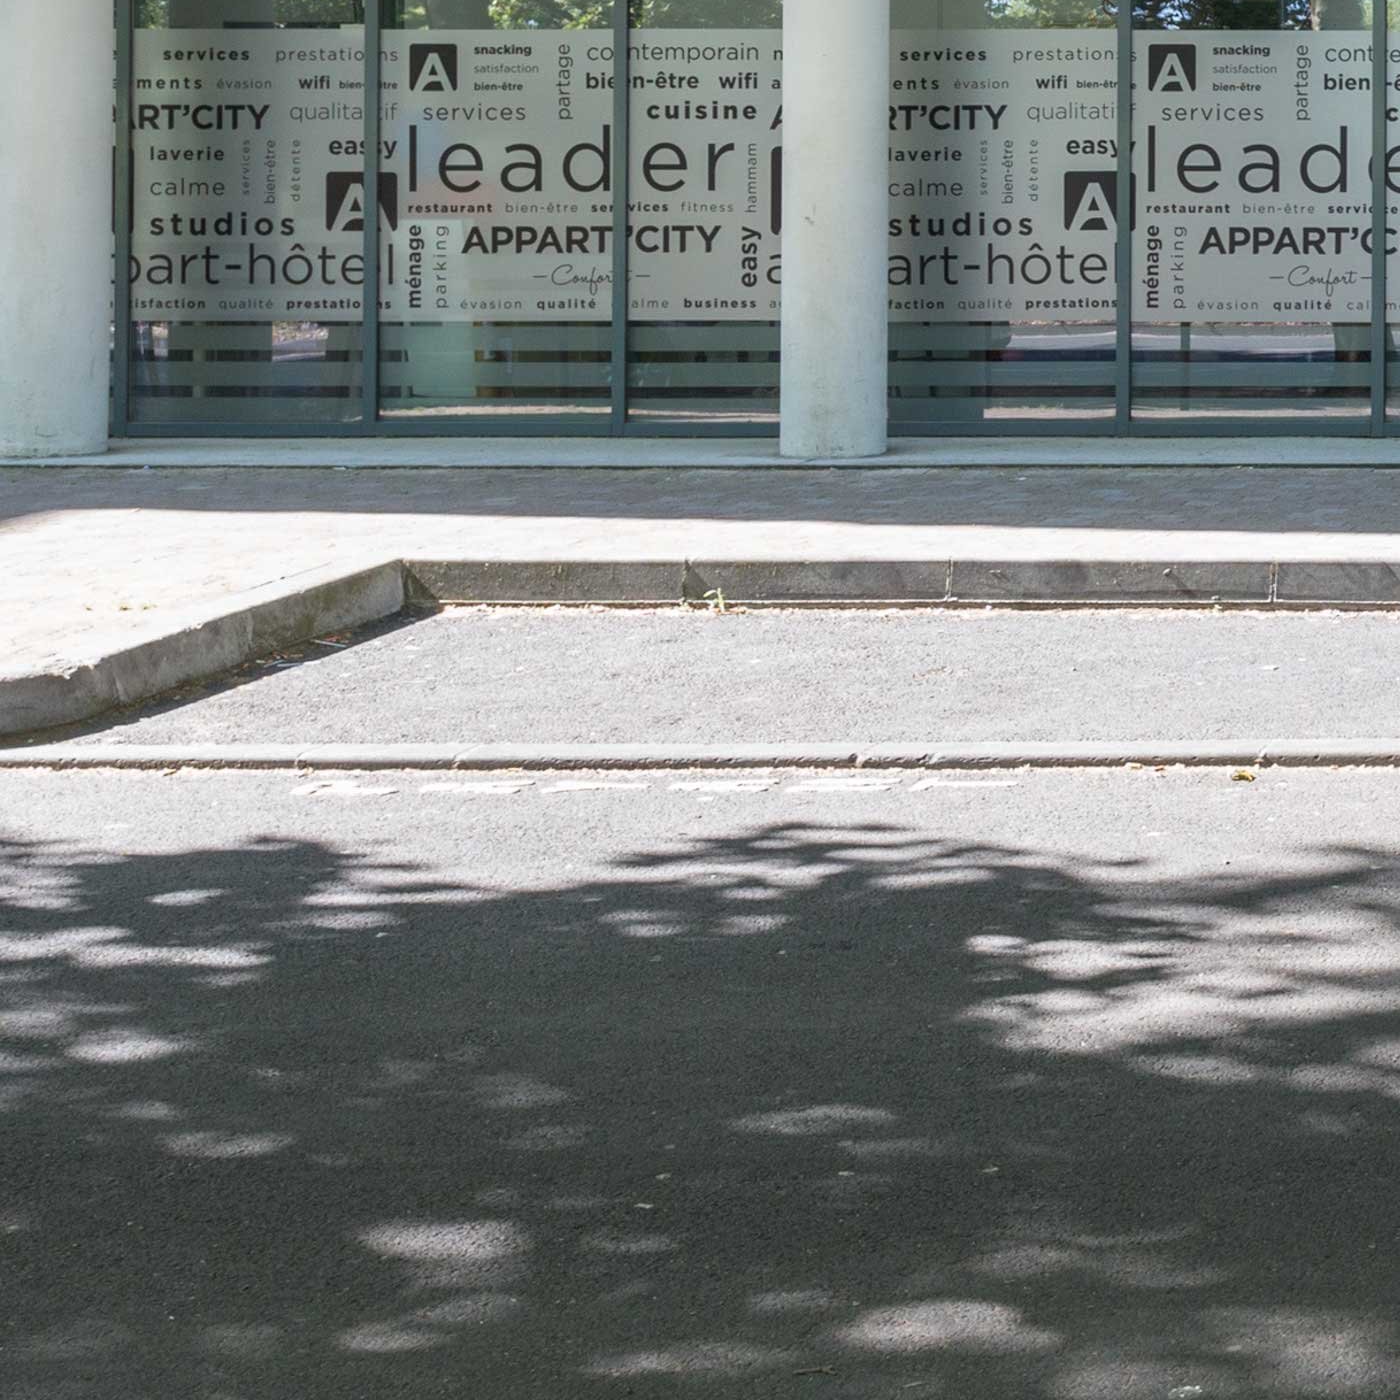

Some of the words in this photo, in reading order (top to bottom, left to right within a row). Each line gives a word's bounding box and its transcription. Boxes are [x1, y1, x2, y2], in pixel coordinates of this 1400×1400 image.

[163, 47, 250, 61] services
[474, 44, 532, 57] snacking
[586, 42, 759, 64] contemporain
[900, 47, 987, 61] services
[1213, 45, 1270, 57] snacking
[474, 63, 539, 74] satisfaction
[1213, 63, 1277, 74] satisfaction
[216, 76, 272, 90] évasion
[298, 75, 330, 89] wifi
[338, 79, 398, 90] bien-tre
[474, 81, 523, 91] bien-être
[556, 43, 574, 121] partage
[719, 72, 758, 89] wifi
[954, 78, 1009, 90] évasion
[1035, 75, 1067, 89] wifi
[1213, 81, 1262, 92] bien-être
[1294, 44, 1311, 121] partage
[130, 104, 270, 130] RT'CITY
[289, 103, 398, 124] qualitaif
[423, 103, 527, 121] services
[646, 101, 757, 120] cuisine
[1161, 103, 1264, 121] services
[150, 147, 225, 161] laverie
[408, 124, 735, 193] leader
[888, 147, 963, 162] laverie
[242, 140, 251, 196] services
[263, 139, 276, 205] bien-être
[289, 140, 300, 202] détente
[979, 140, 988, 196] services
[1002, 139, 1014, 205] bien-être
[1028, 139, 1039, 202] détente
[150, 178, 225, 196] calme
[743, 143, 758, 213] hammam
[888, 178, 964, 197] calme
[408, 204, 493, 214] restaurant
[505, 202, 578, 213] bien-être
[681, 201, 734, 212] fitness
[1146, 204, 1231, 214] restaurant
[1242, 203, 1316, 214] bien-être
[150, 211, 295, 236] studios
[888, 211, 1033, 236] studios
[461, 225, 722, 253] APPART'CITY
[741, 226, 761, 287] easy
[405, 225, 424, 308] ménage
[433, 226, 449, 309] parking
[1142, 225, 1162, 308] ménage
[1170, 226, 1187, 309] parking
[1288, 265, 1357, 297] Confort
[218, 299, 274, 312] qualité
[460, 297, 522, 309] évasion
[536, 297, 597, 310] qualité
[683, 298, 757, 309] business
[958, 299, 1012, 312] qualité
[1197, 299, 1259, 311] évasion
[1273, 299, 1332, 312] qualité
